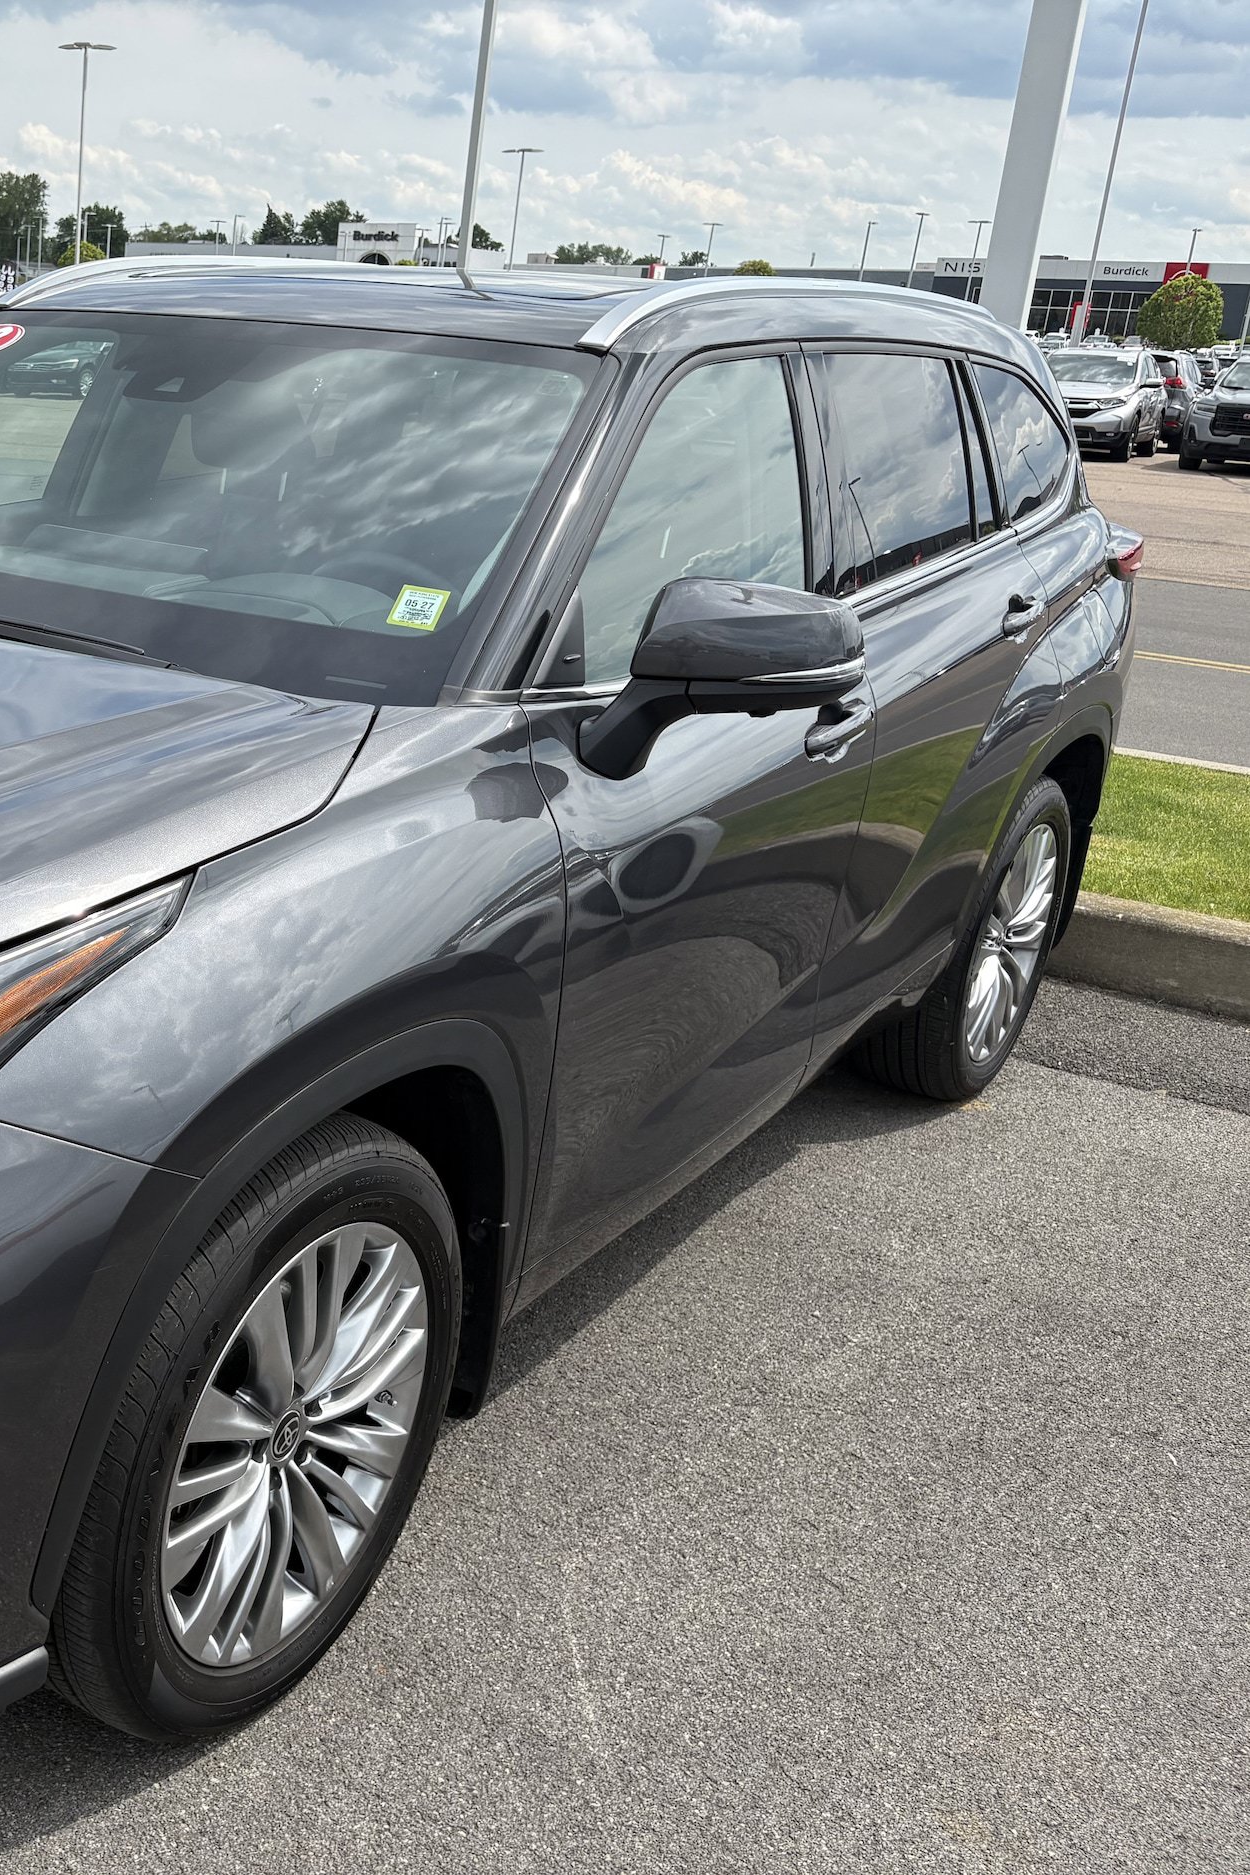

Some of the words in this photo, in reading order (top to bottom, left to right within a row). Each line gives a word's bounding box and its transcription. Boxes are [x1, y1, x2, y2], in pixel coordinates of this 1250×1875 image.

[353, 231, 400, 242] Burdick
[944, 262, 985, 273] NIS
[1103, 266, 1149, 276] Burdick
[404, 599, 418, 608] 05
[420, 601, 435, 610] 27
